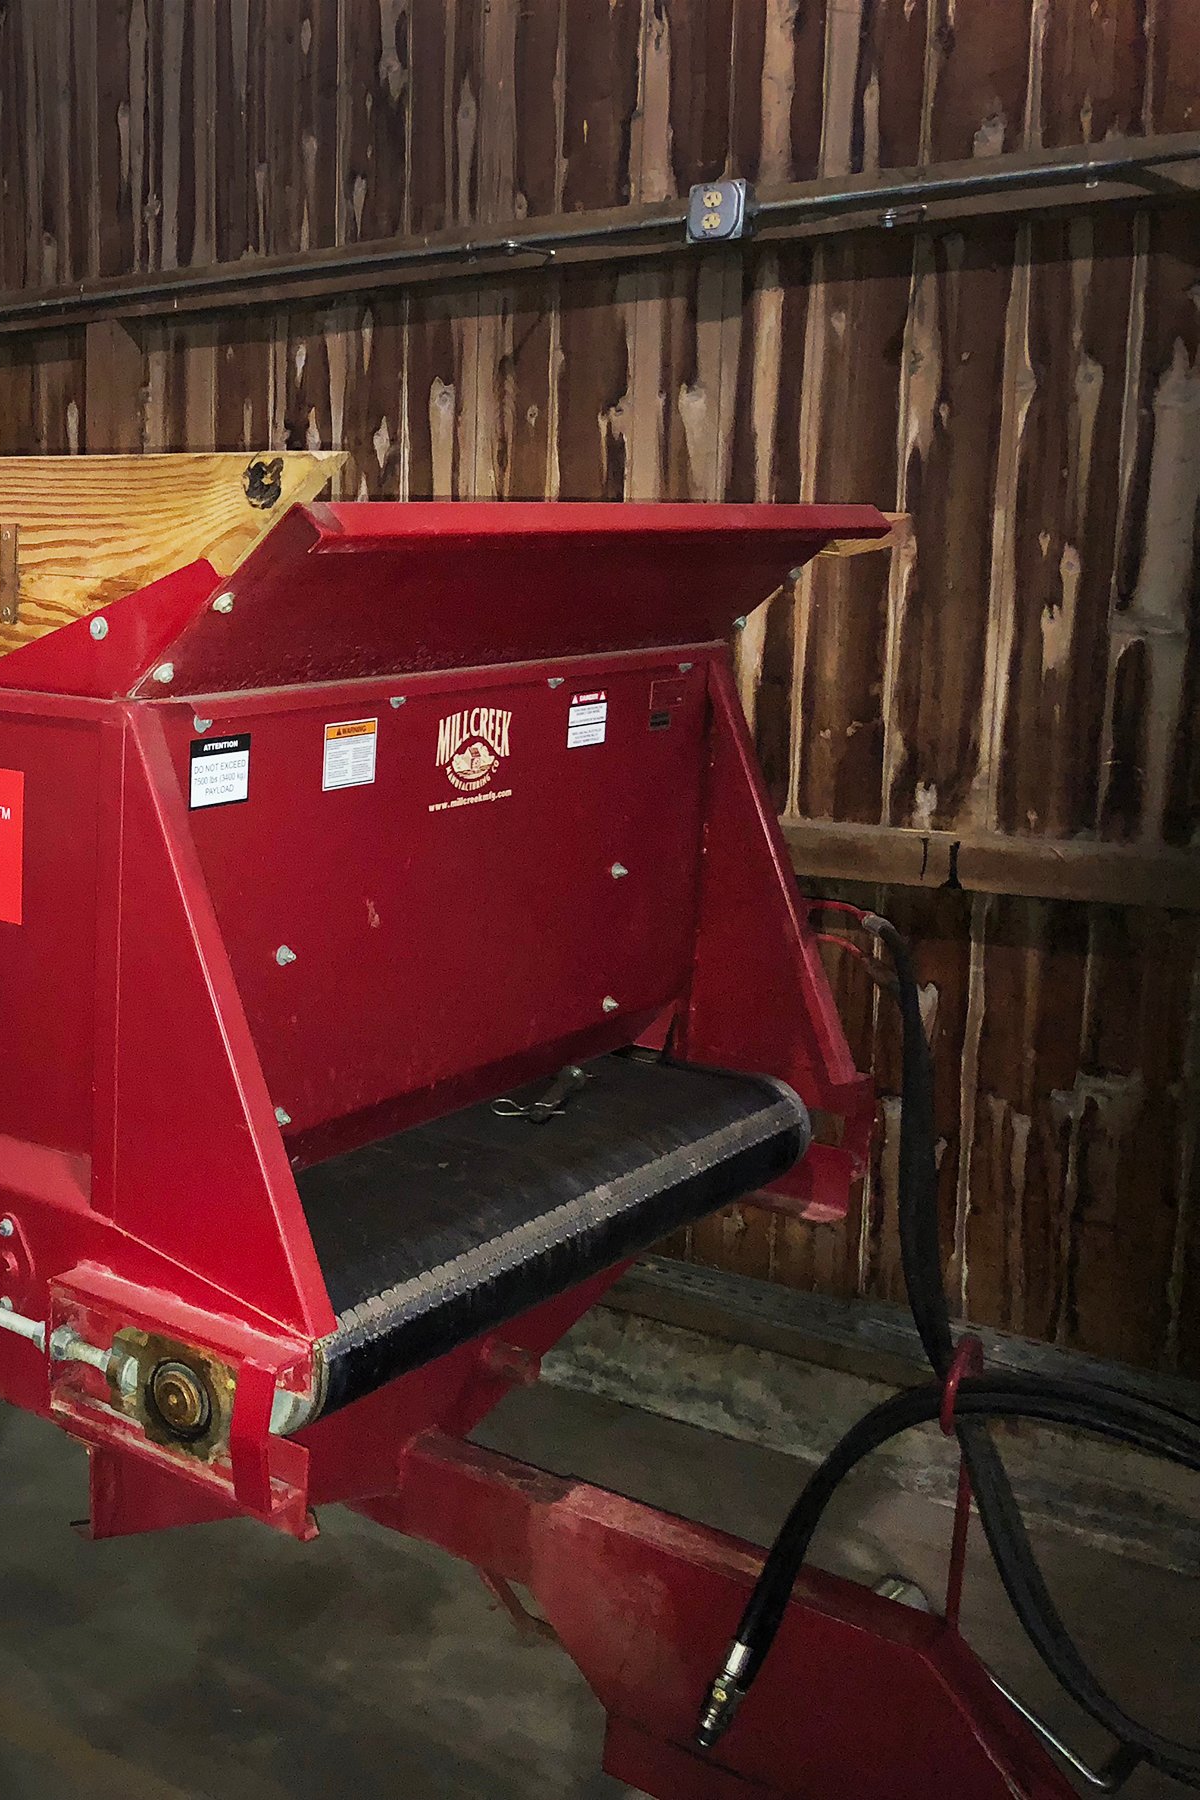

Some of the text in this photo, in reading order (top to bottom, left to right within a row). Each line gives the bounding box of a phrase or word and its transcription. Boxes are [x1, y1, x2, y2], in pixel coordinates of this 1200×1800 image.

[435, 707, 512, 767] MILLCREEK
[203, 741, 238, 751] ATTENTION
[194, 760, 246, 775] DO NOT EXCEED
[194, 776, 209, 786] 7500
[205, 784, 234, 795] PAYLOAD
[428, 789, 512, 812] www.millcreekmfg.com
